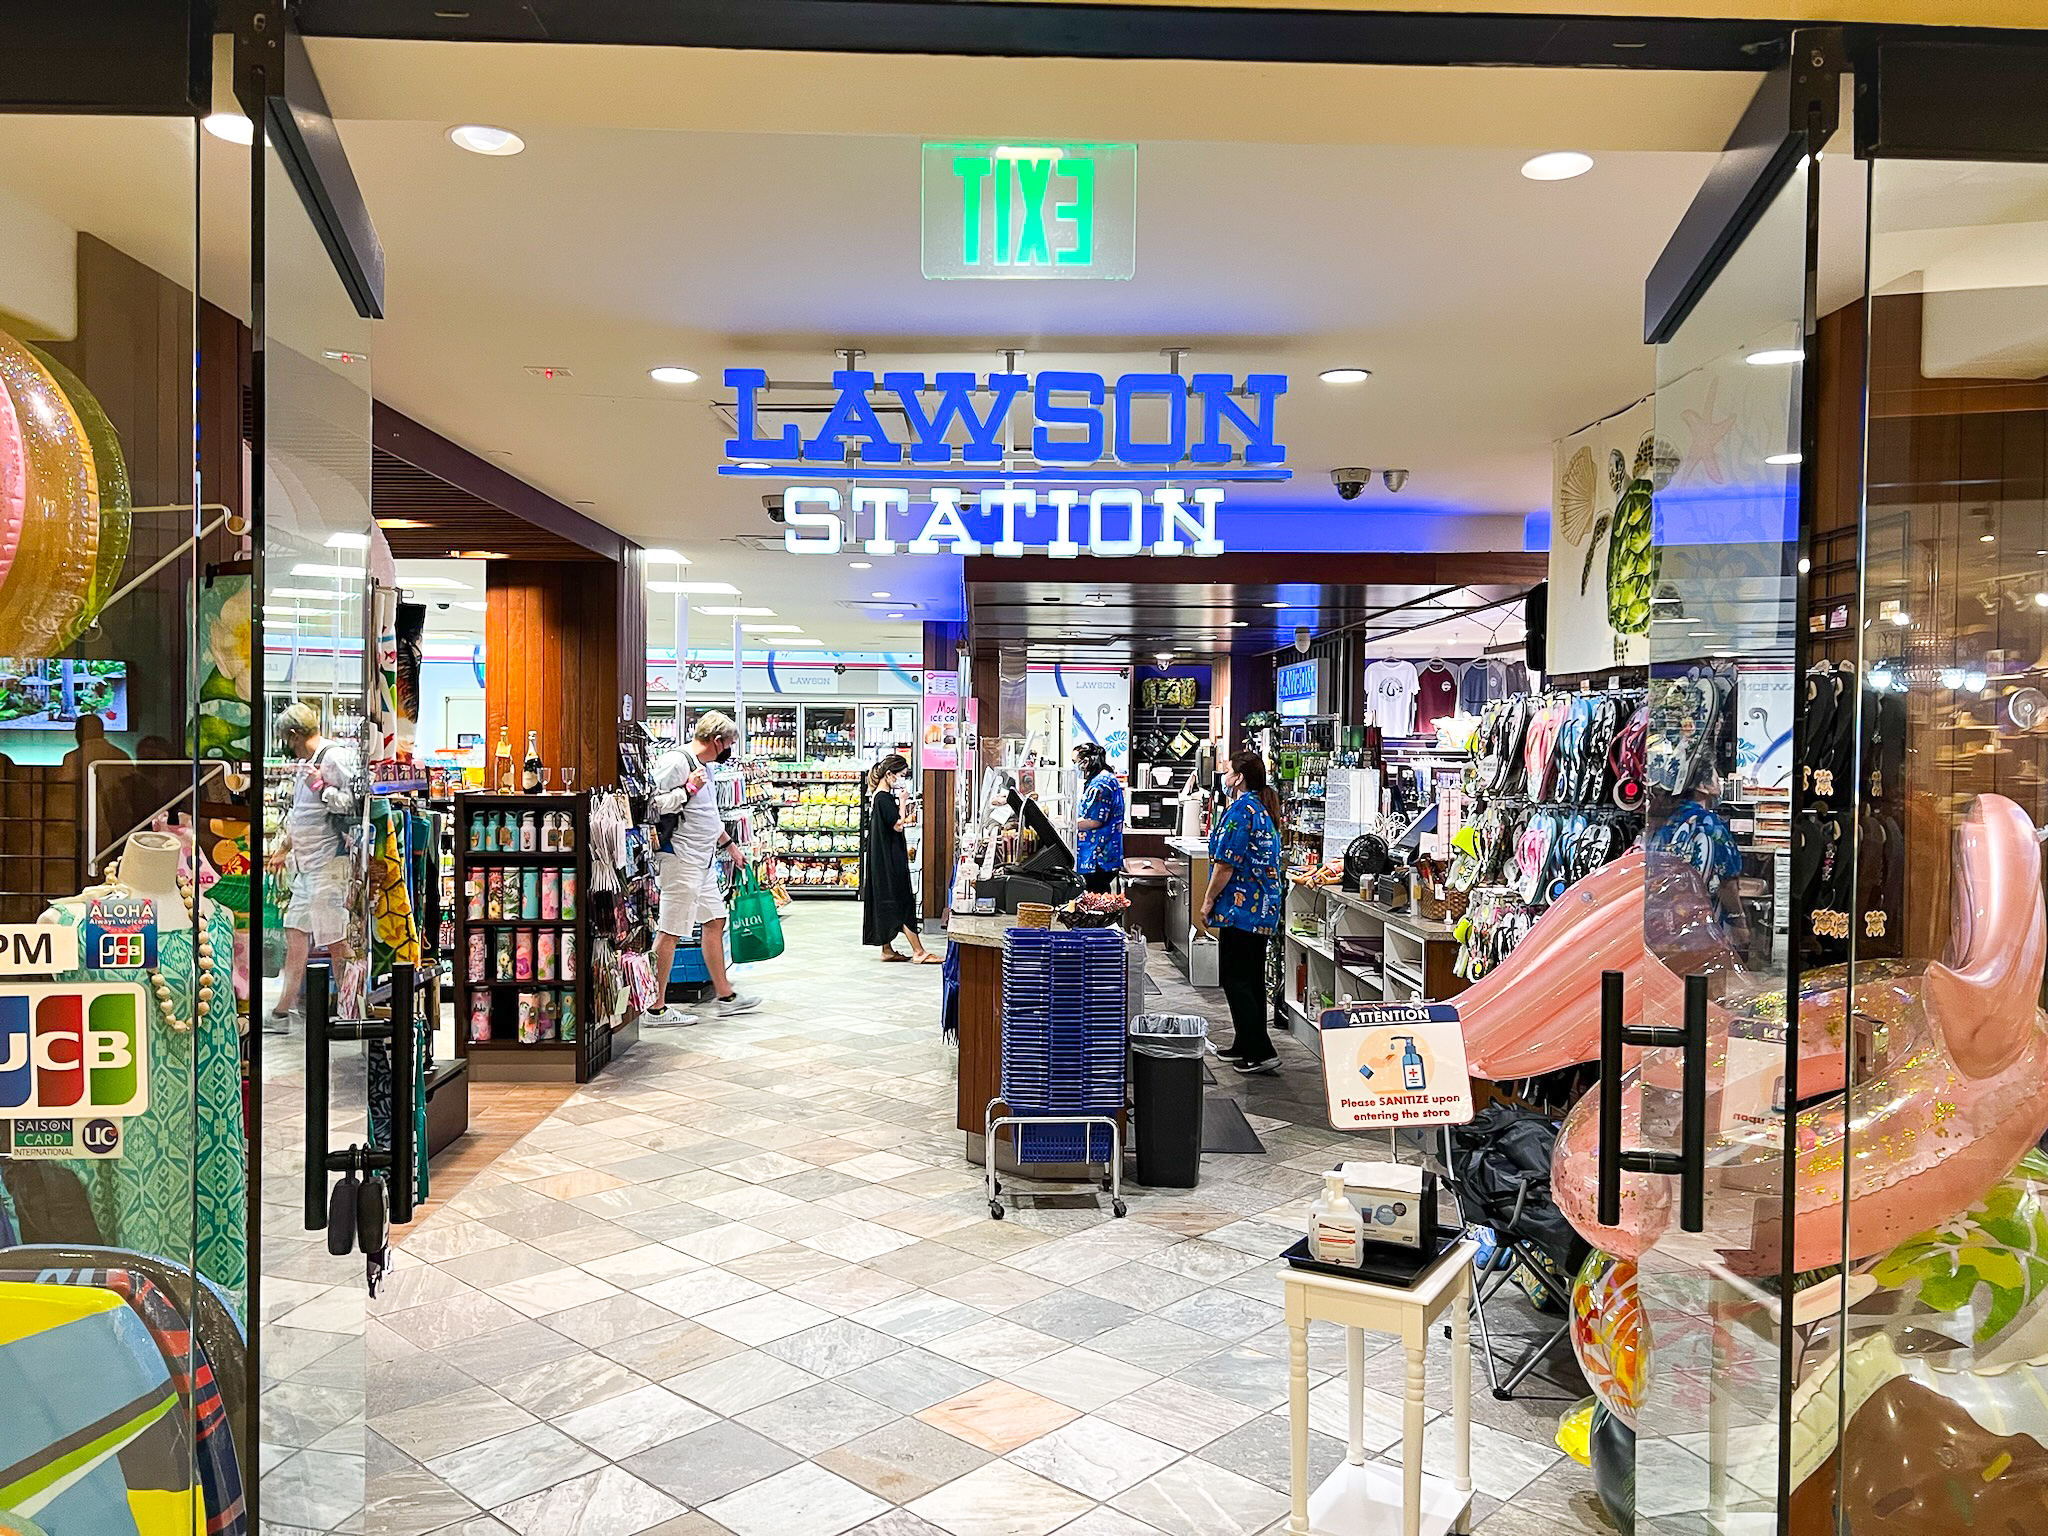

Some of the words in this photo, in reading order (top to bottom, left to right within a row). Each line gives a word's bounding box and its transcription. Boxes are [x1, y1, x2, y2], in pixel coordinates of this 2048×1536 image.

[724, 368, 1289, 465] LAWSON
[783, 486, 1225, 557] STATION
[789, 677, 831, 685] LAWSON
[1076, 681, 1116, 689] LAWSON
[90, 904, 154, 918] ALOHA
[102, 944, 141, 957] JCB
[1349, 1009, 1430, 1024] ATTENTION
[1341, 1098, 1376, 1108] Please
[1379, 1095, 1429, 1105] SANITIZE
[1431, 1095, 1460, 1106] upon
[1354, 1110, 1399, 1122] entering
[1402, 1109, 1419, 1119] the
[1423, 1109, 1450, 1119] store
[16, 1120, 71, 1132] SAISON
[24, 1133, 64, 1146] CARD
[14, 1148, 74, 1157] INTERNATIONAL
